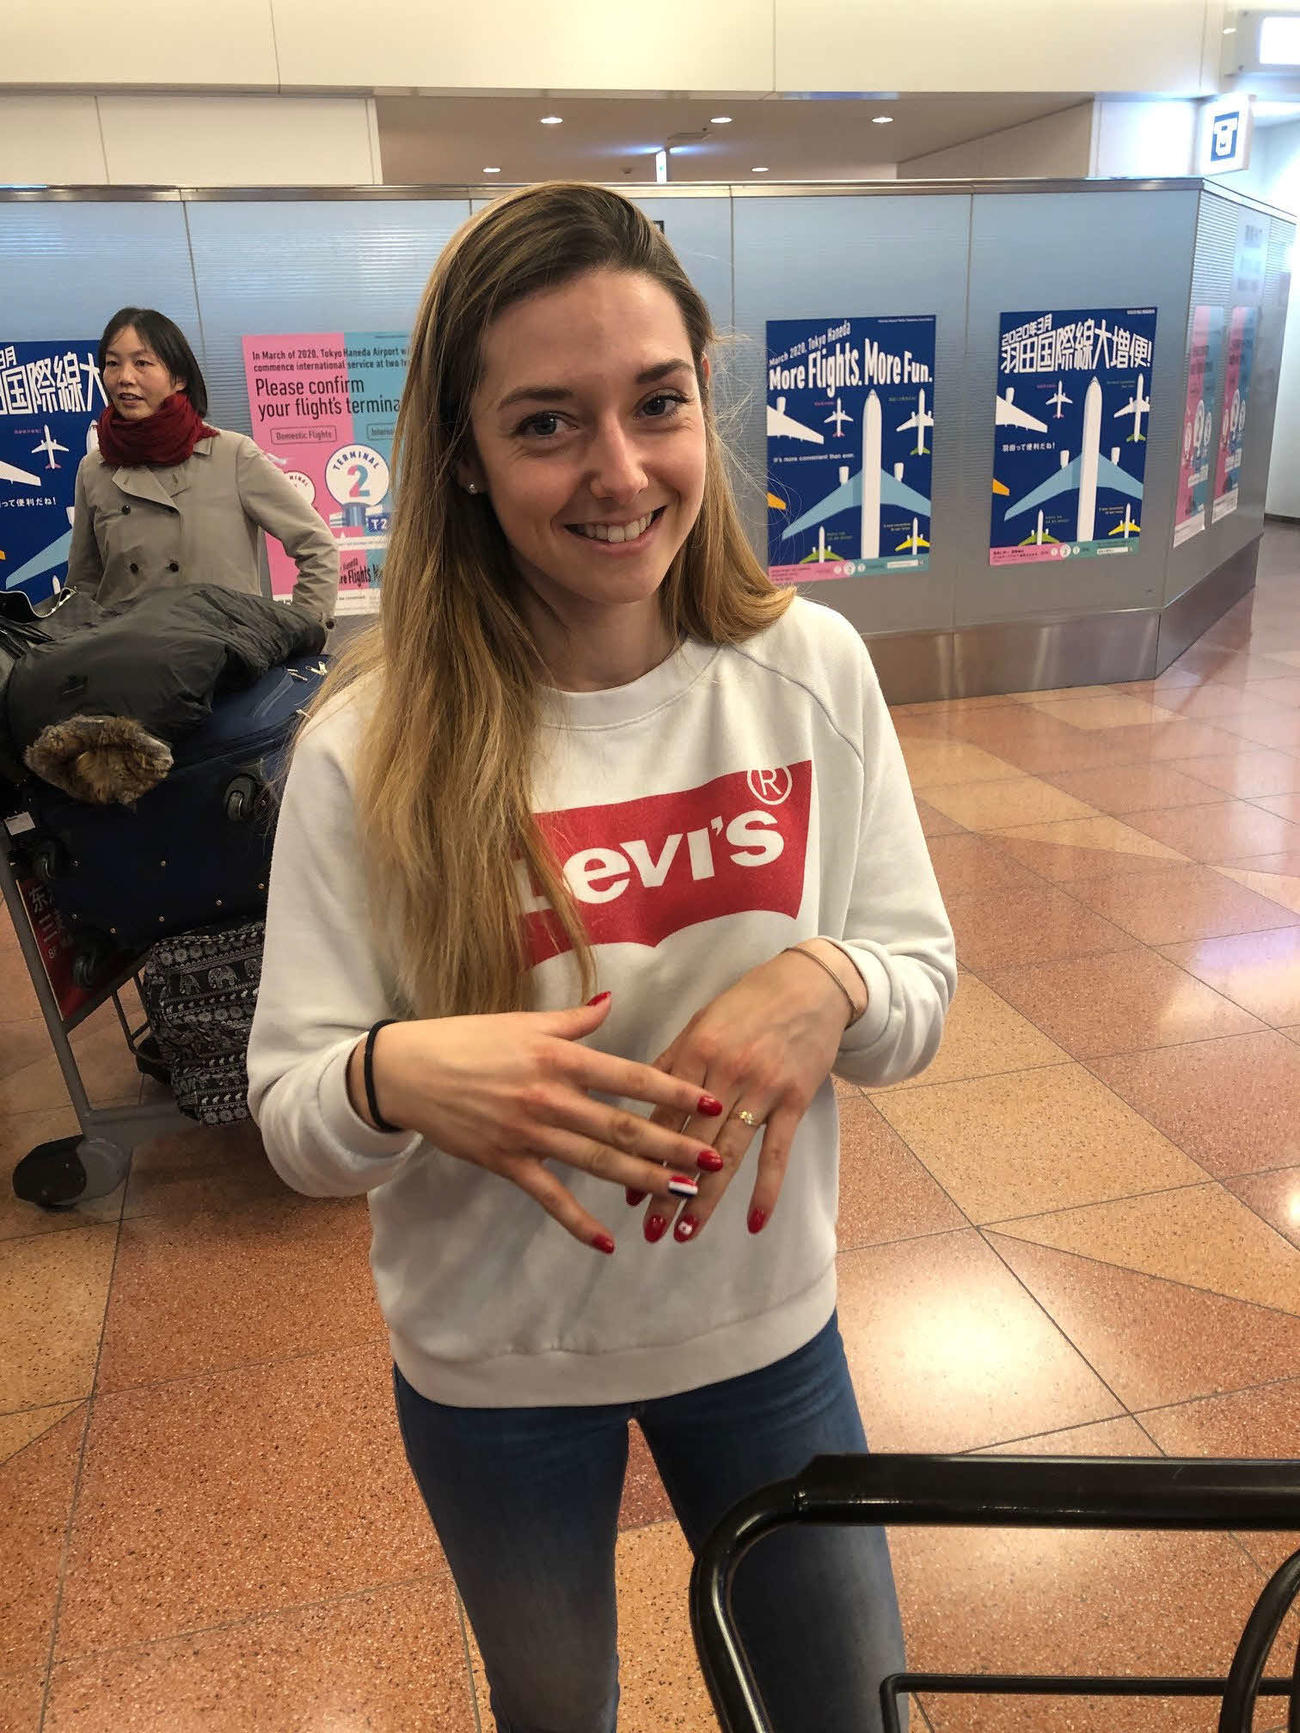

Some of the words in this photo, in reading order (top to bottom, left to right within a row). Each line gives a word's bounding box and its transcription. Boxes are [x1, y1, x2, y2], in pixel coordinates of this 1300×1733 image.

[769, 351, 788, 366] March
[808, 334, 826, 350] Tokyo
[828, 320, 851, 343] Haneda
[1001, 313, 1052, 346] 2020年3月
[252, 351, 260, 361] In
[262, 350, 286, 360] March
[288, 350, 296, 360] of
[321, 349, 342, 361] Tokyo
[343, 347, 371, 358] Haneda
[373, 347, 399, 360] Airport
[1000, 318, 1152, 374] 羽田国際線大増便!
[253, 362, 295, 372] commence
[296, 360, 345, 371] international
[347, 359, 374, 370] service
[376, 358, 384, 368] at
[385, 358, 400, 368] two
[769, 365, 806, 391] More
[808, 342, 862, 398] Flights.
[864, 337, 901, 386] More
[903, 350, 933, 384] Fun.
[0, 352, 109, 415] 国際線大
[256, 377, 304, 396] Please
[308, 375, 365, 395] confirm
[258, 401, 290, 422] your
[295, 396, 342, 420] flight's
[346, 395, 400, 414] termina
[275, 431, 307, 441] Domestic
[308, 430, 332, 441] Flights
[333, 451, 380, 471] TERMINAL
[347, 464, 371, 498] 2
[0, 497, 57, 508] って便利だね!
